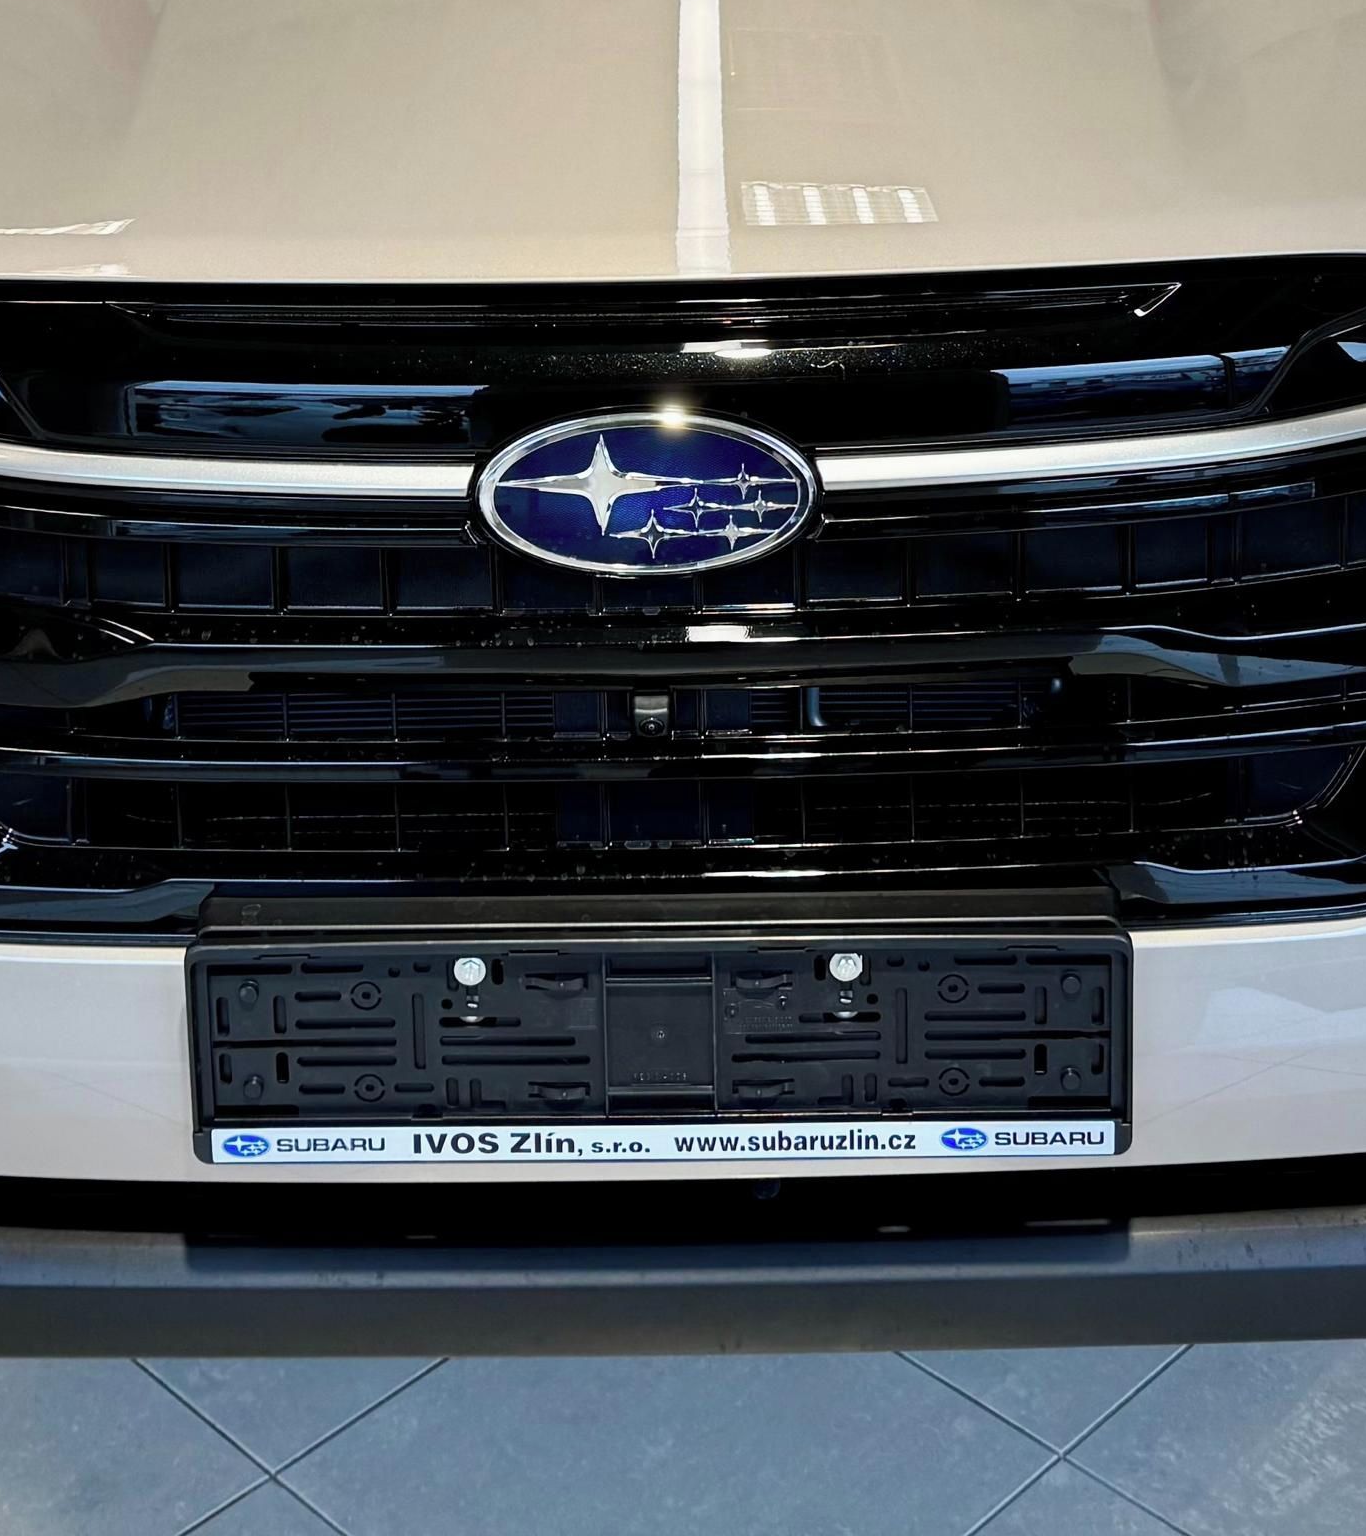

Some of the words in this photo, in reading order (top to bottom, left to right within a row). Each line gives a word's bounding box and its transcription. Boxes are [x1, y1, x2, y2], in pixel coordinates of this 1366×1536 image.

[276, 1137, 386, 1152] SUBARU
[413, 1133, 499, 1154] IVOS
[510, 1131, 583, 1157] Zlín,
[591, 1139, 651, 1154] s.r.o.
[674, 1129, 916, 1152] www.subaruzlin.cz
[994, 1130, 1105, 1146] SUBARU
